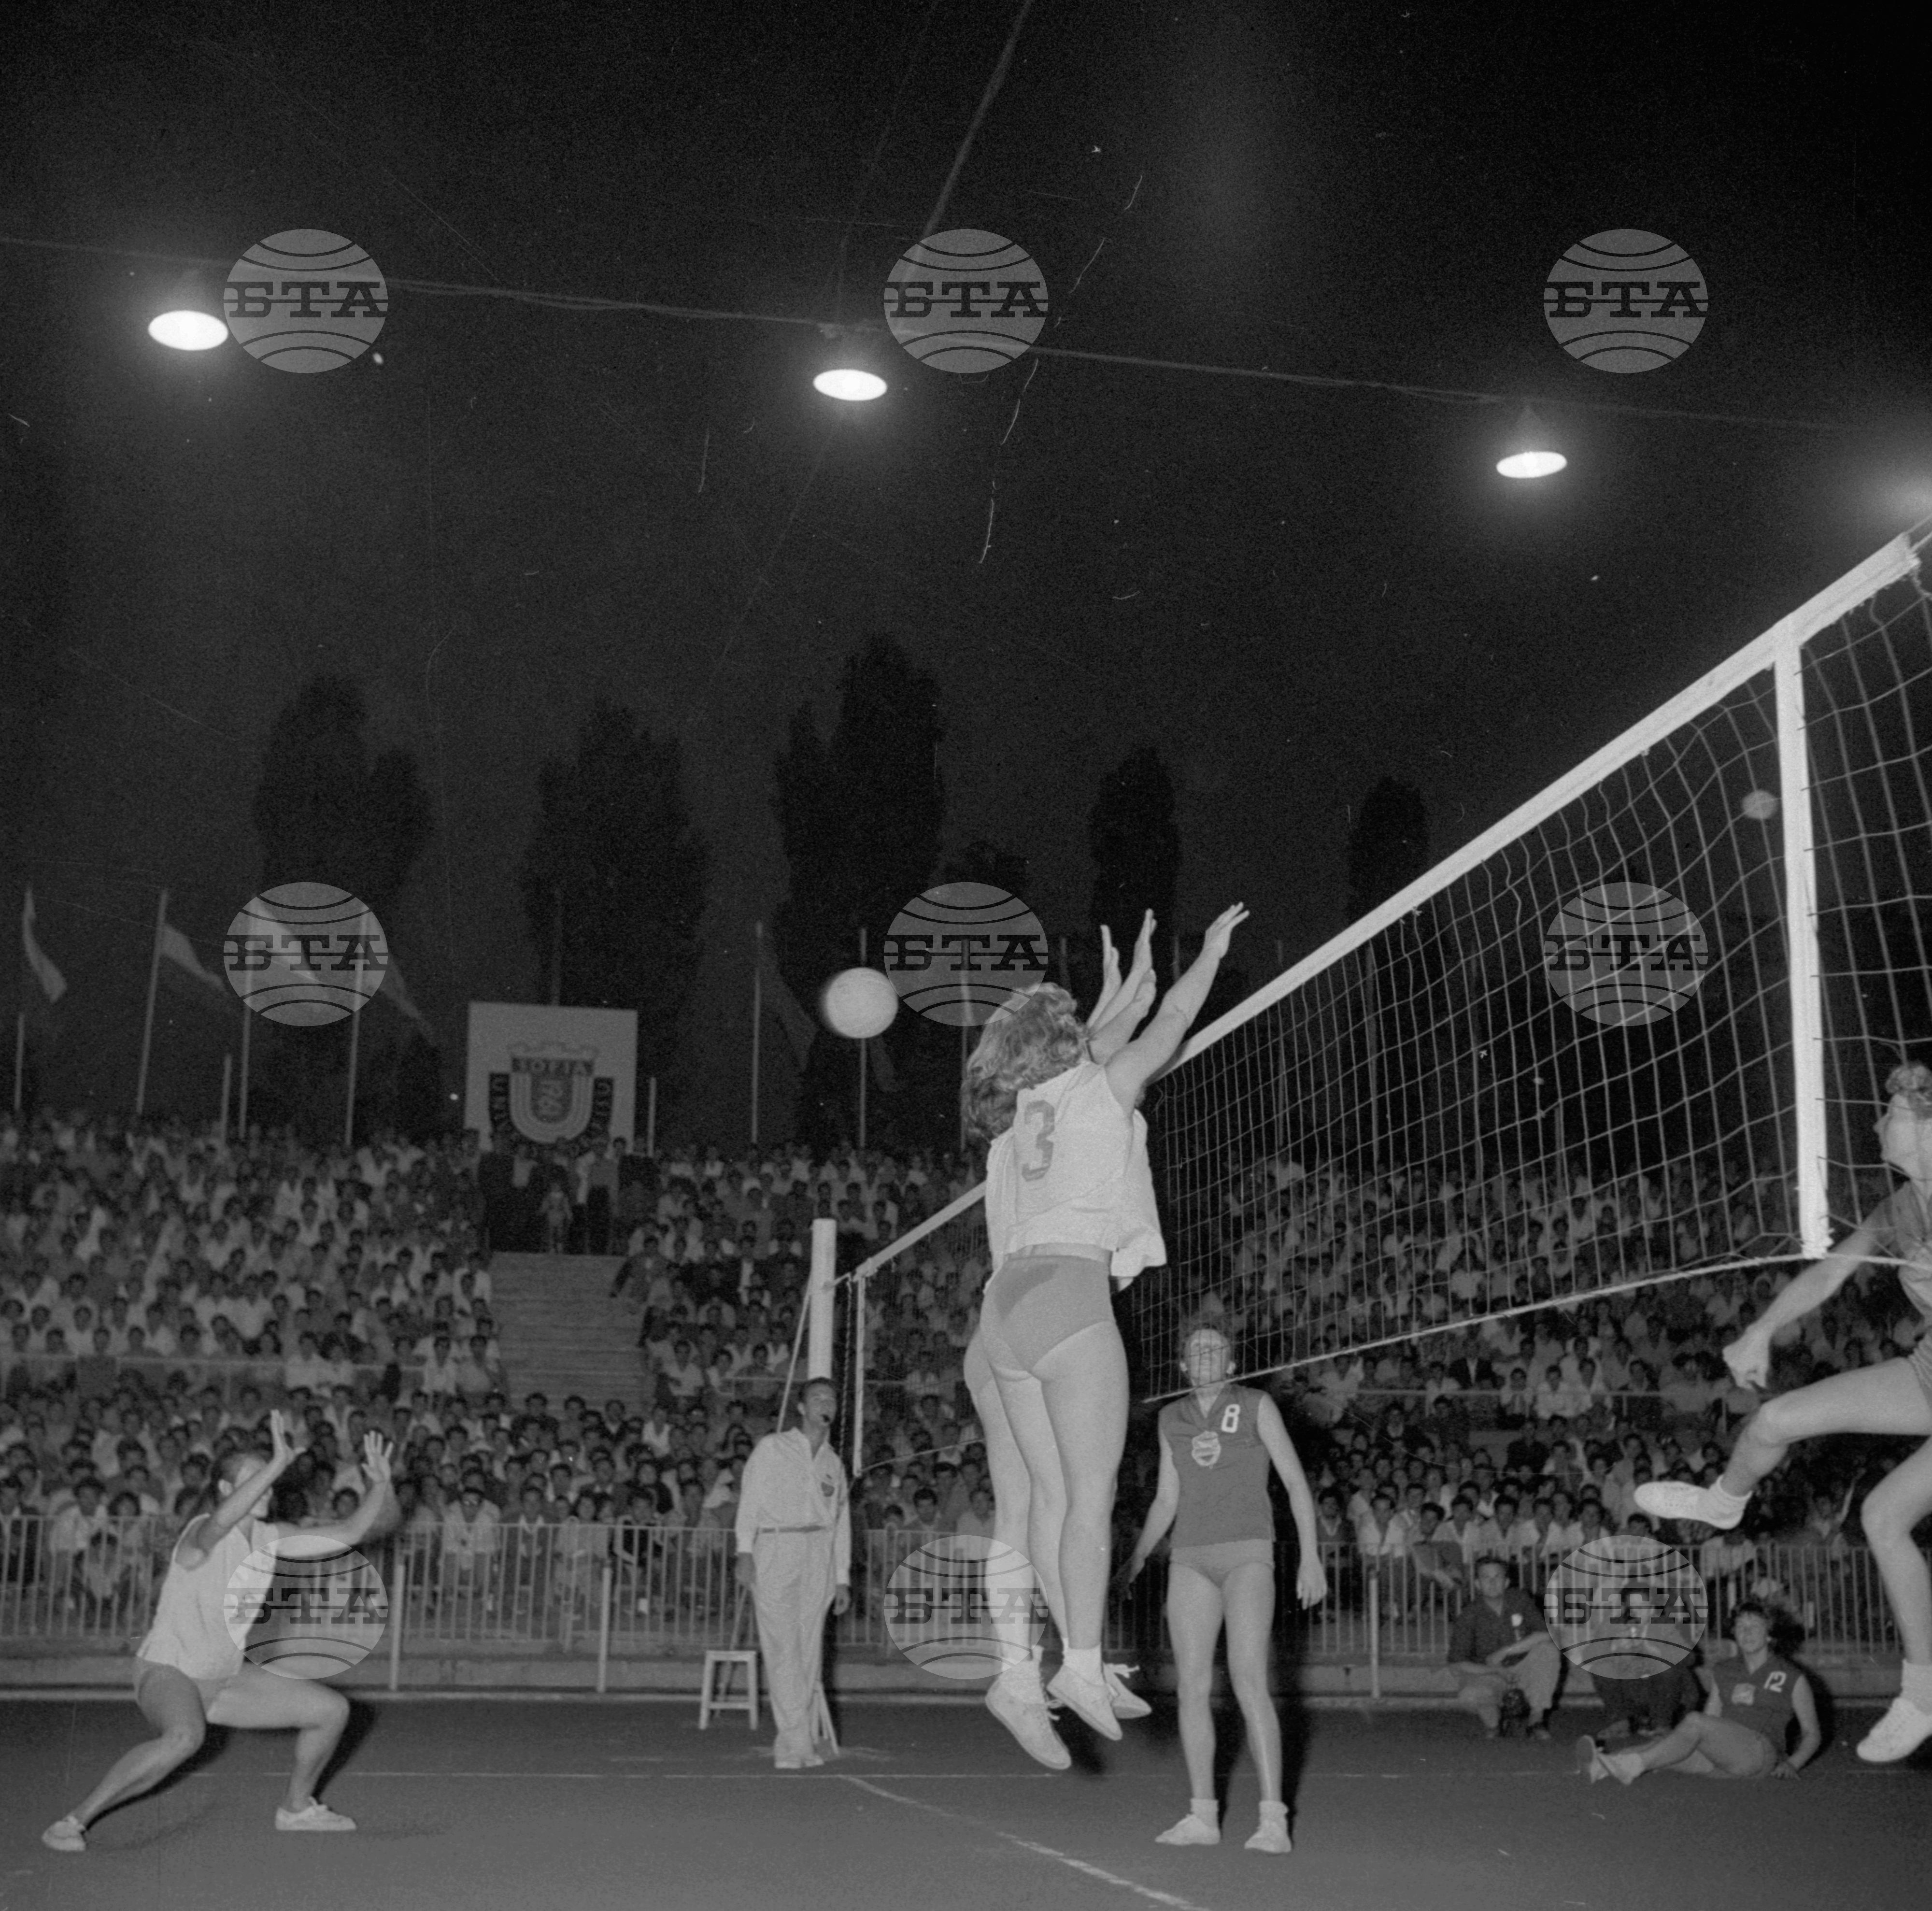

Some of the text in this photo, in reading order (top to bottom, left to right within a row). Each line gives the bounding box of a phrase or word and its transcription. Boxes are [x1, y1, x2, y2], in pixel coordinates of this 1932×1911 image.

[1022, 1099, 1055, 1182] 3
[1221, 1404, 1240, 1433] 8
[1764, 1671, 1787, 1692] 12
